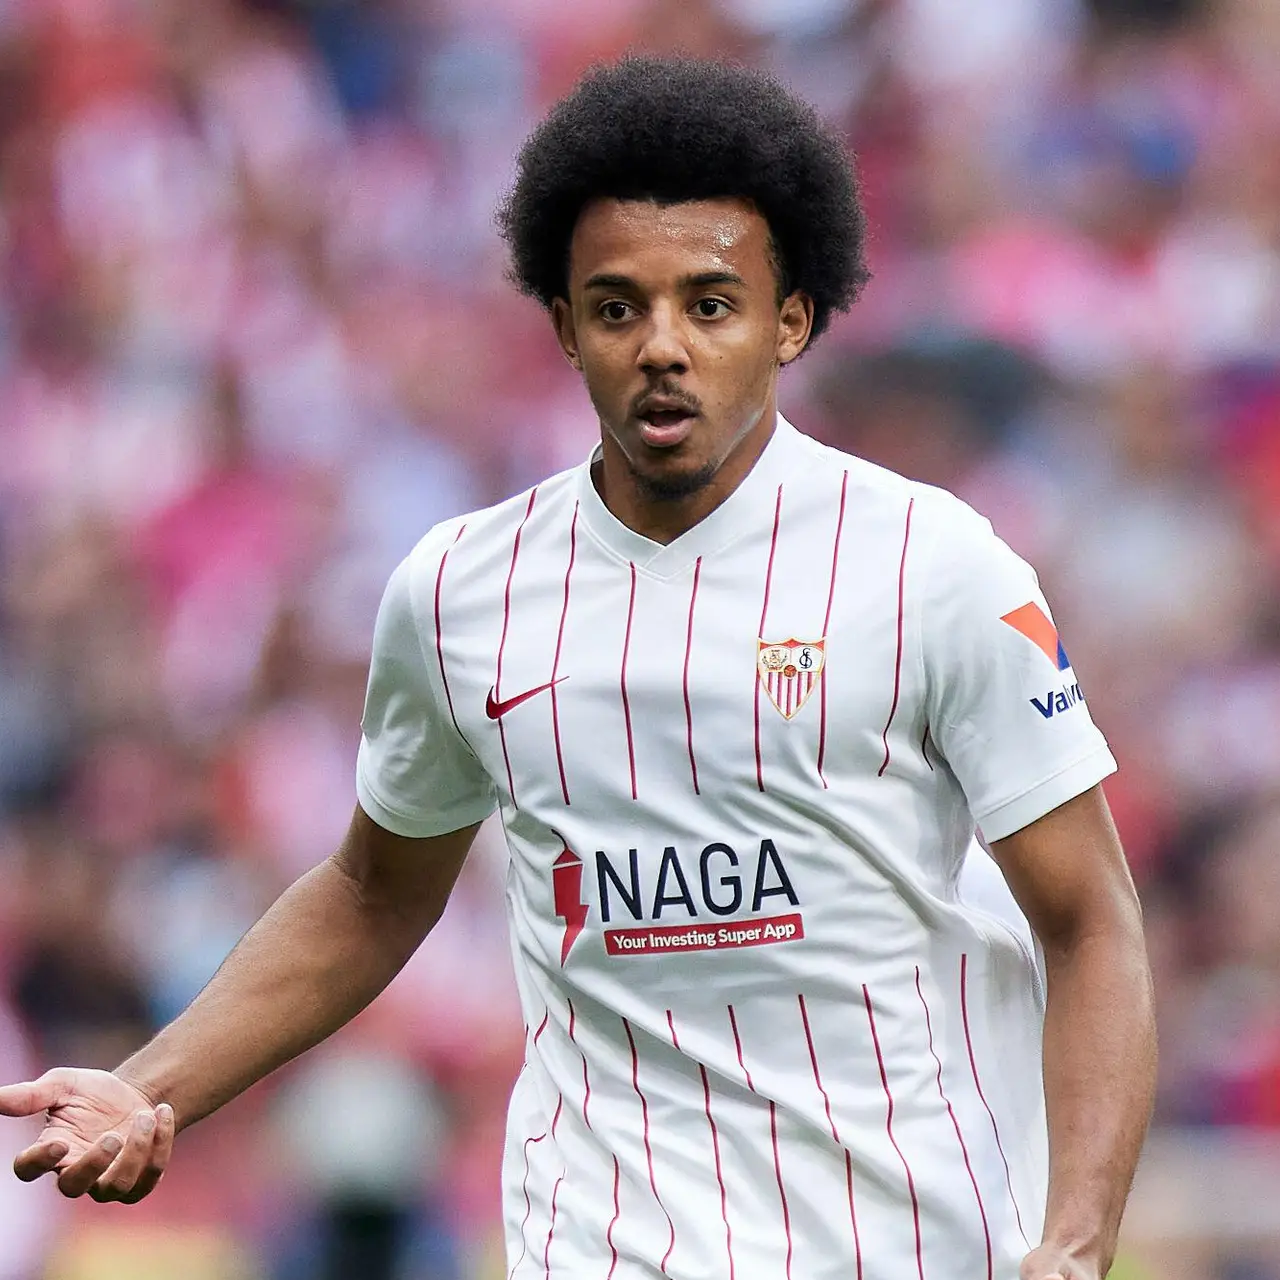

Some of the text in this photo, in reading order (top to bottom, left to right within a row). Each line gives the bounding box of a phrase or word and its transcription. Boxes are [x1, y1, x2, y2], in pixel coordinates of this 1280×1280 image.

[595, 838, 800, 923] NAGA
[613, 922, 796, 950] Your Investing Super App
